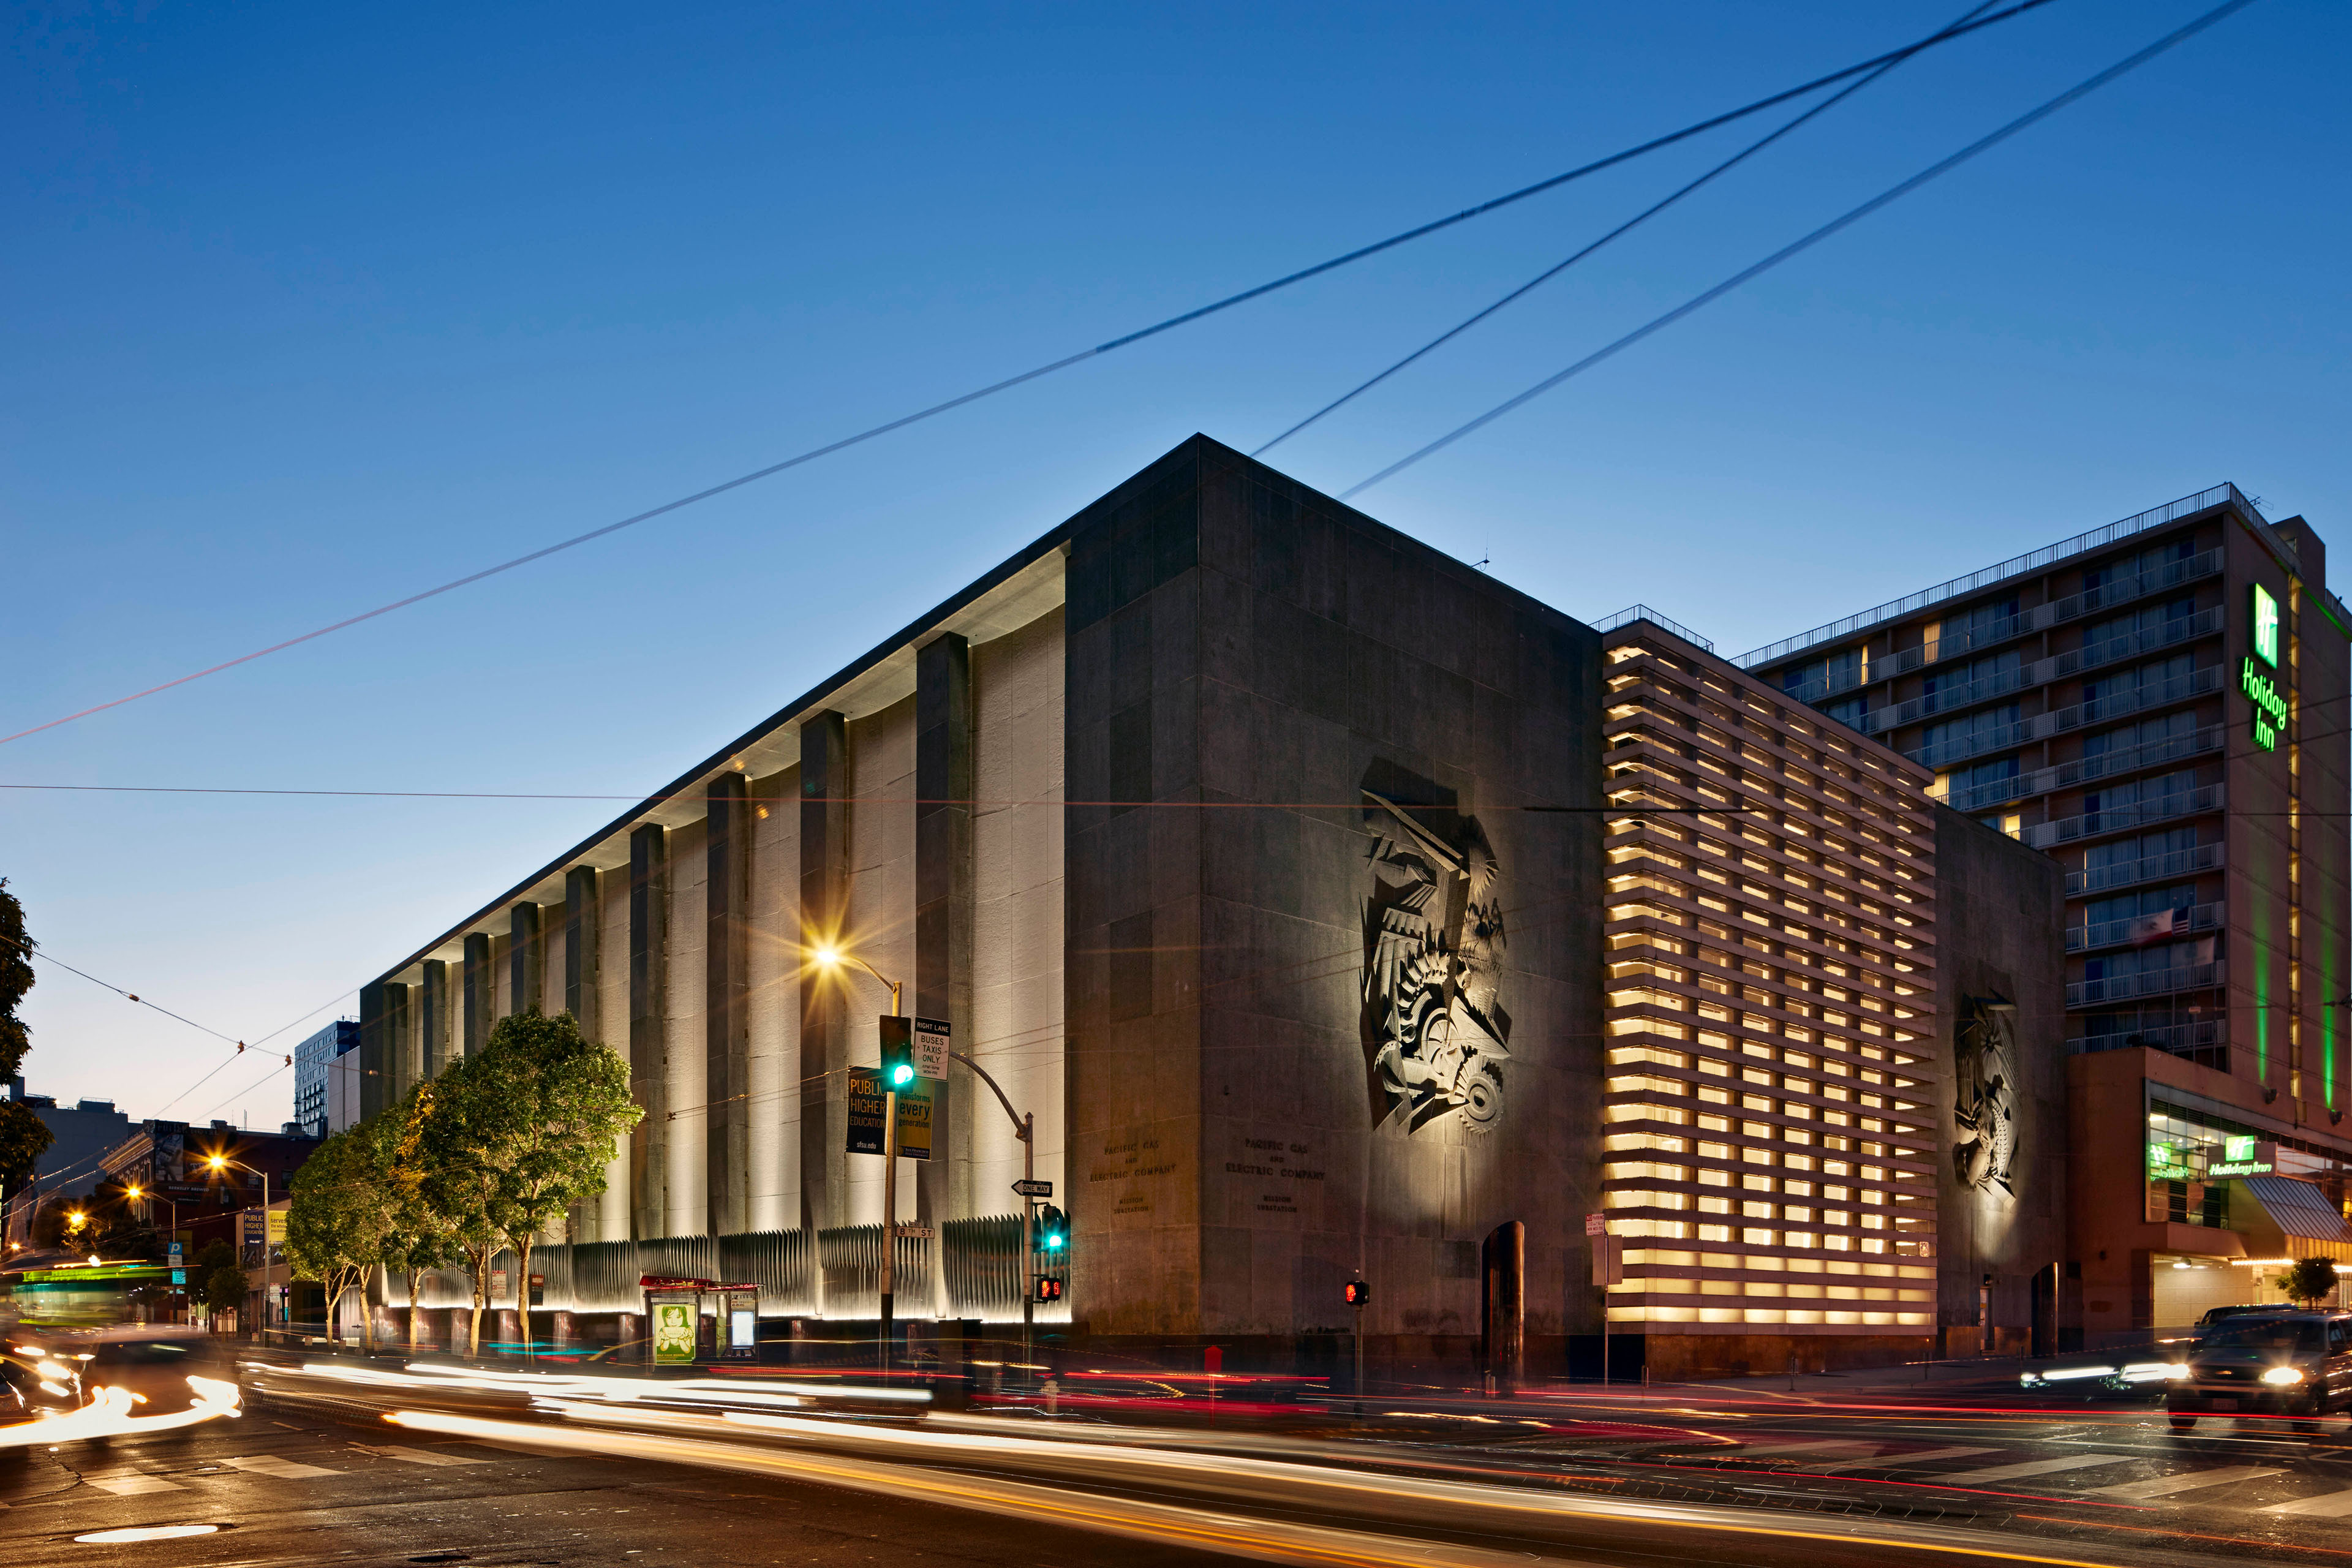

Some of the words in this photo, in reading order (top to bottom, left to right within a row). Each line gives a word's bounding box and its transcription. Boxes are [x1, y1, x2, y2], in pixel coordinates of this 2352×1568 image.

[2243, 657, 2286, 730] Holiday
[921, 1035, 944, 1046] BUSES
[922, 1045, 941, 1054] TAXIS
[922, 1054, 940, 1064] ONLY
[899, 1093, 930, 1102] transforms
[851, 1098, 886, 1115] HIGHER
[899, 1102, 930, 1120] every
[850, 1116, 886, 1128] EDUCATION
[899, 1118, 929, 1128] generation
[1104, 1143, 1137, 1155] PACIFIC
[1143, 1140, 1159, 1150] GAS
[1245, 1138, 1284, 1150] PACIFIC
[1290, 1144, 1308, 1154] GAS
[1090, 1170, 1128, 1182] ELECTRIC
[1134, 1163, 1176, 1177] COMPANY
[1226, 1163, 1273, 1175] ELECTRIC
[1281, 1168, 1325, 1180] COMPANY
[2209, 1163, 2252, 1176] Holiday
[1119, 1196, 1143, 1205] MISSION
[1114, 1205, 1149, 1214] SUBSTATION
[1257, 1204, 1297, 1213] SUBSTATION
